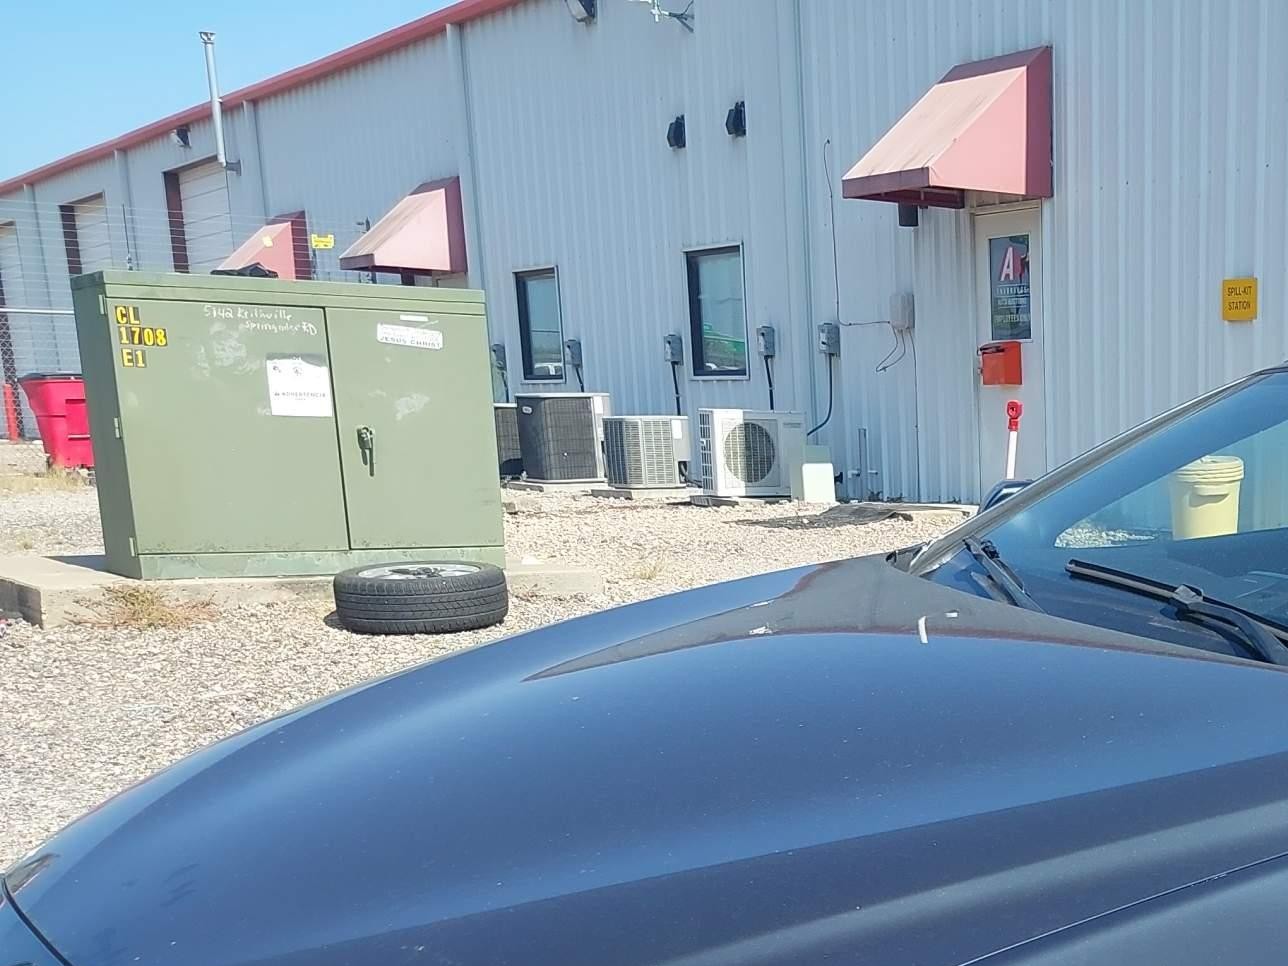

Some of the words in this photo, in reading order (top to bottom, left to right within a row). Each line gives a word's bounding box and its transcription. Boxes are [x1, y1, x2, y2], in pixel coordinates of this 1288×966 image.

[1228, 300, 1252, 311] STATION
[116, 306, 140, 324] CL
[119, 327, 167, 346] 1708
[122, 349, 146, 367] E1
